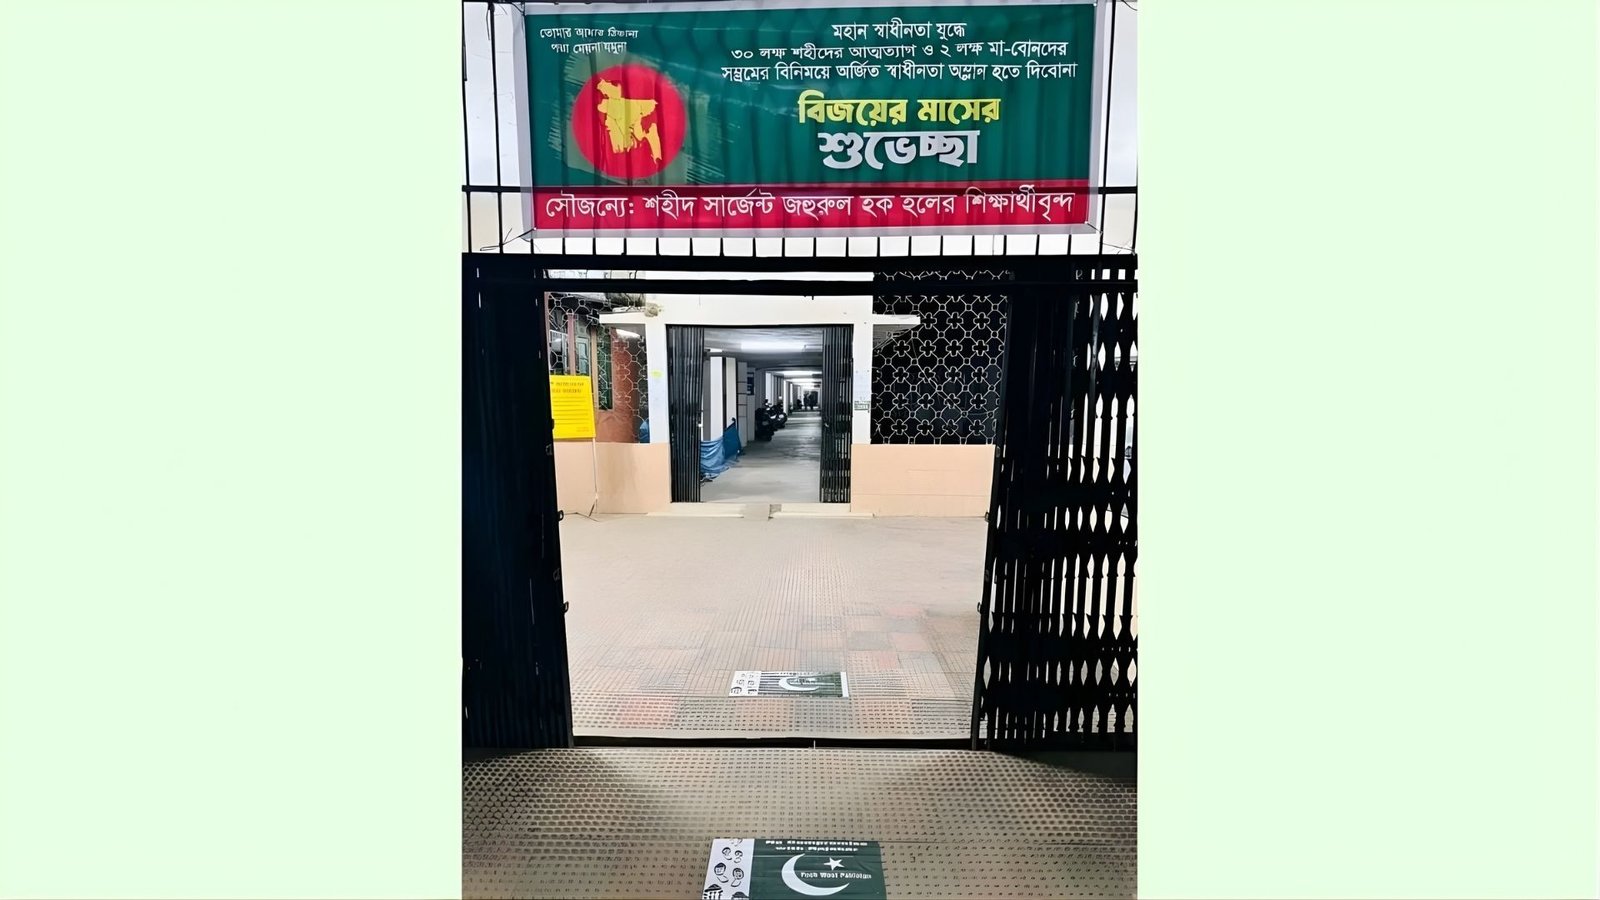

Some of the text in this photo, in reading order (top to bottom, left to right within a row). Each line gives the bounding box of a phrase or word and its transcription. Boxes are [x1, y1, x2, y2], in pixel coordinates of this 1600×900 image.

[832, 17, 967, 41] মহান স্বাধীনতা যুদ্ধে
[731, 39, 1068, 60] ৩০ লক্ষ শহীদের আত্মত্যাগ ও ২ লক্ষ মা-বোনদের
[774, 61, 831, 80] বিনিময়ে
[835, 60, 881, 79] অর্জিত
[885, 59, 945, 80] স্বাধীনতা
[949, 62, 988, 81] অম্লান
[992, 64, 1022, 81] হতে
[1025, 59, 1078, 79] দিবোনা
[798, 89, 1002, 127] বিজয়ের মাসের
[817, 129, 981, 171] শুভেচ্ছা
[643, 189, 697, 220] শহীদ
[701, 188, 775, 218] সার্জেন্ট
[781, 194, 854, 220] জহুরুল
[859, 195, 895, 217] হক
[900, 194, 957, 217] হলের
[963, 184, 1075, 221] শিক্ষার্থীবৃন্দ
